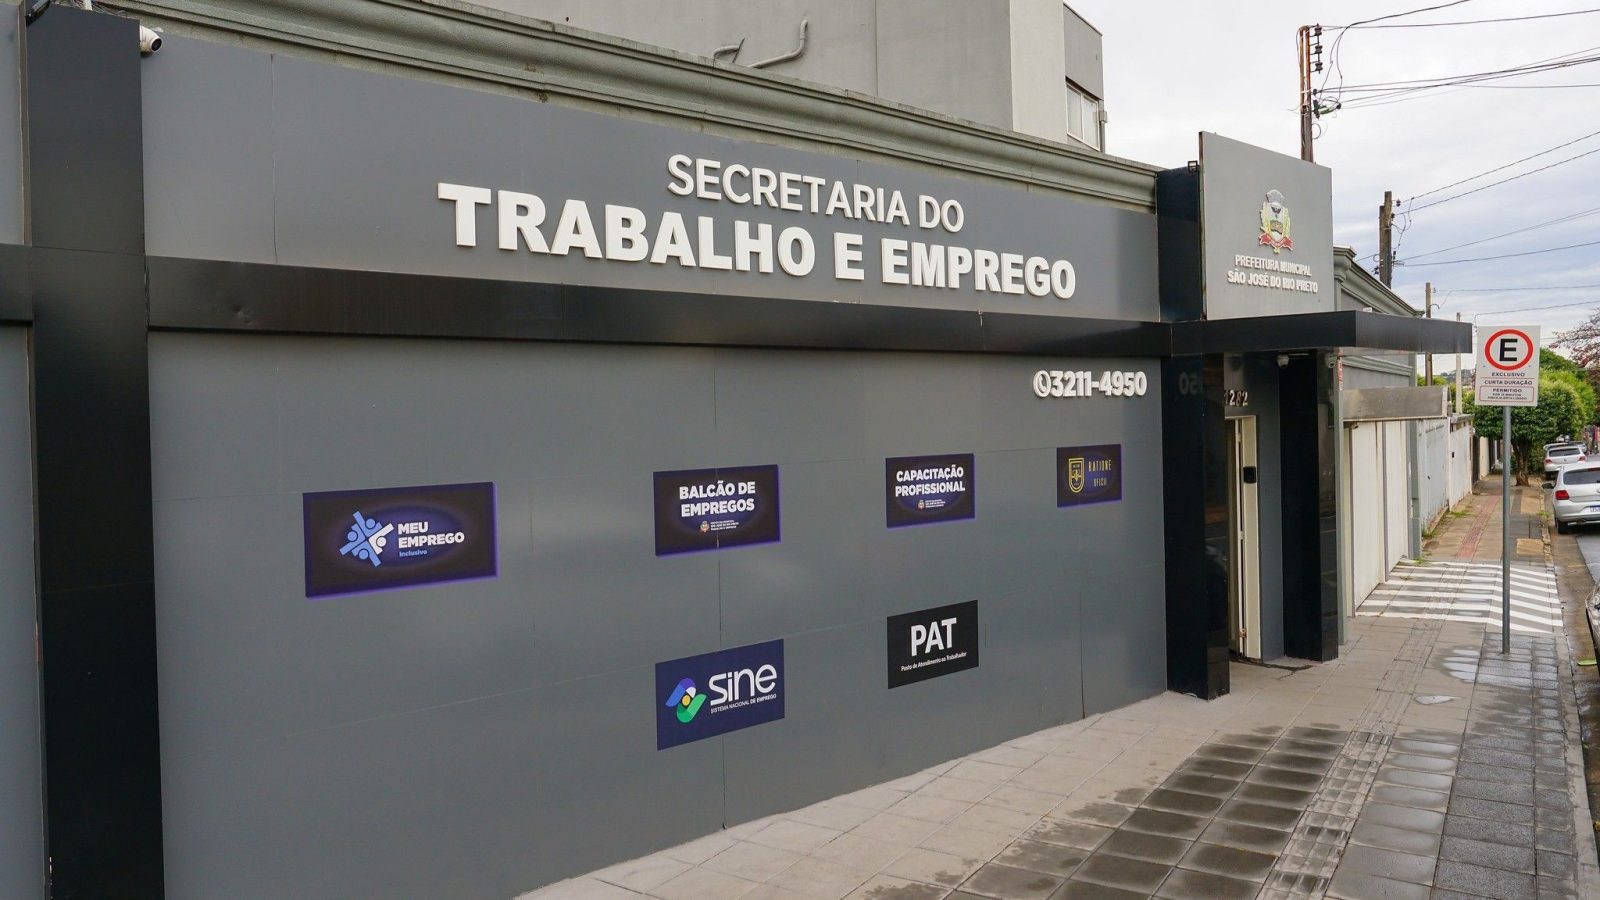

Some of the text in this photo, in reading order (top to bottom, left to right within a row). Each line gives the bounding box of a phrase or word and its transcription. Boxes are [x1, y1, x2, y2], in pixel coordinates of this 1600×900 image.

[667, 154, 964, 233] SECRETARIA DO
[437, 182, 1076, 299] TRABALHO E EMPREGO
[1235, 254, 1312, 276] PREFEITURA MUNICIPAL
[1227, 268, 1318, 294] SÃO JOSÉ DO RIO PRETO
[1499, 338, 1518, 361] E
[1049, 370, 1147, 397] 3211-4950
[896, 464, 964, 482] CAPACITAÇÃO
[679, 480, 756, 500] BALCÃO DE
[895, 481, 966, 497] PROFISSIONAL
[681, 498, 755, 518] EMPREGOS
[397, 521, 429, 535] MEU
[398, 531, 465, 549] EMPREGO
[911, 617, 957, 657] PAT
[710, 705, 729, 714] SISTEMA
[728, 701, 750, 709] NACIONAL
[756, 693, 777, 703] EMPREGO
